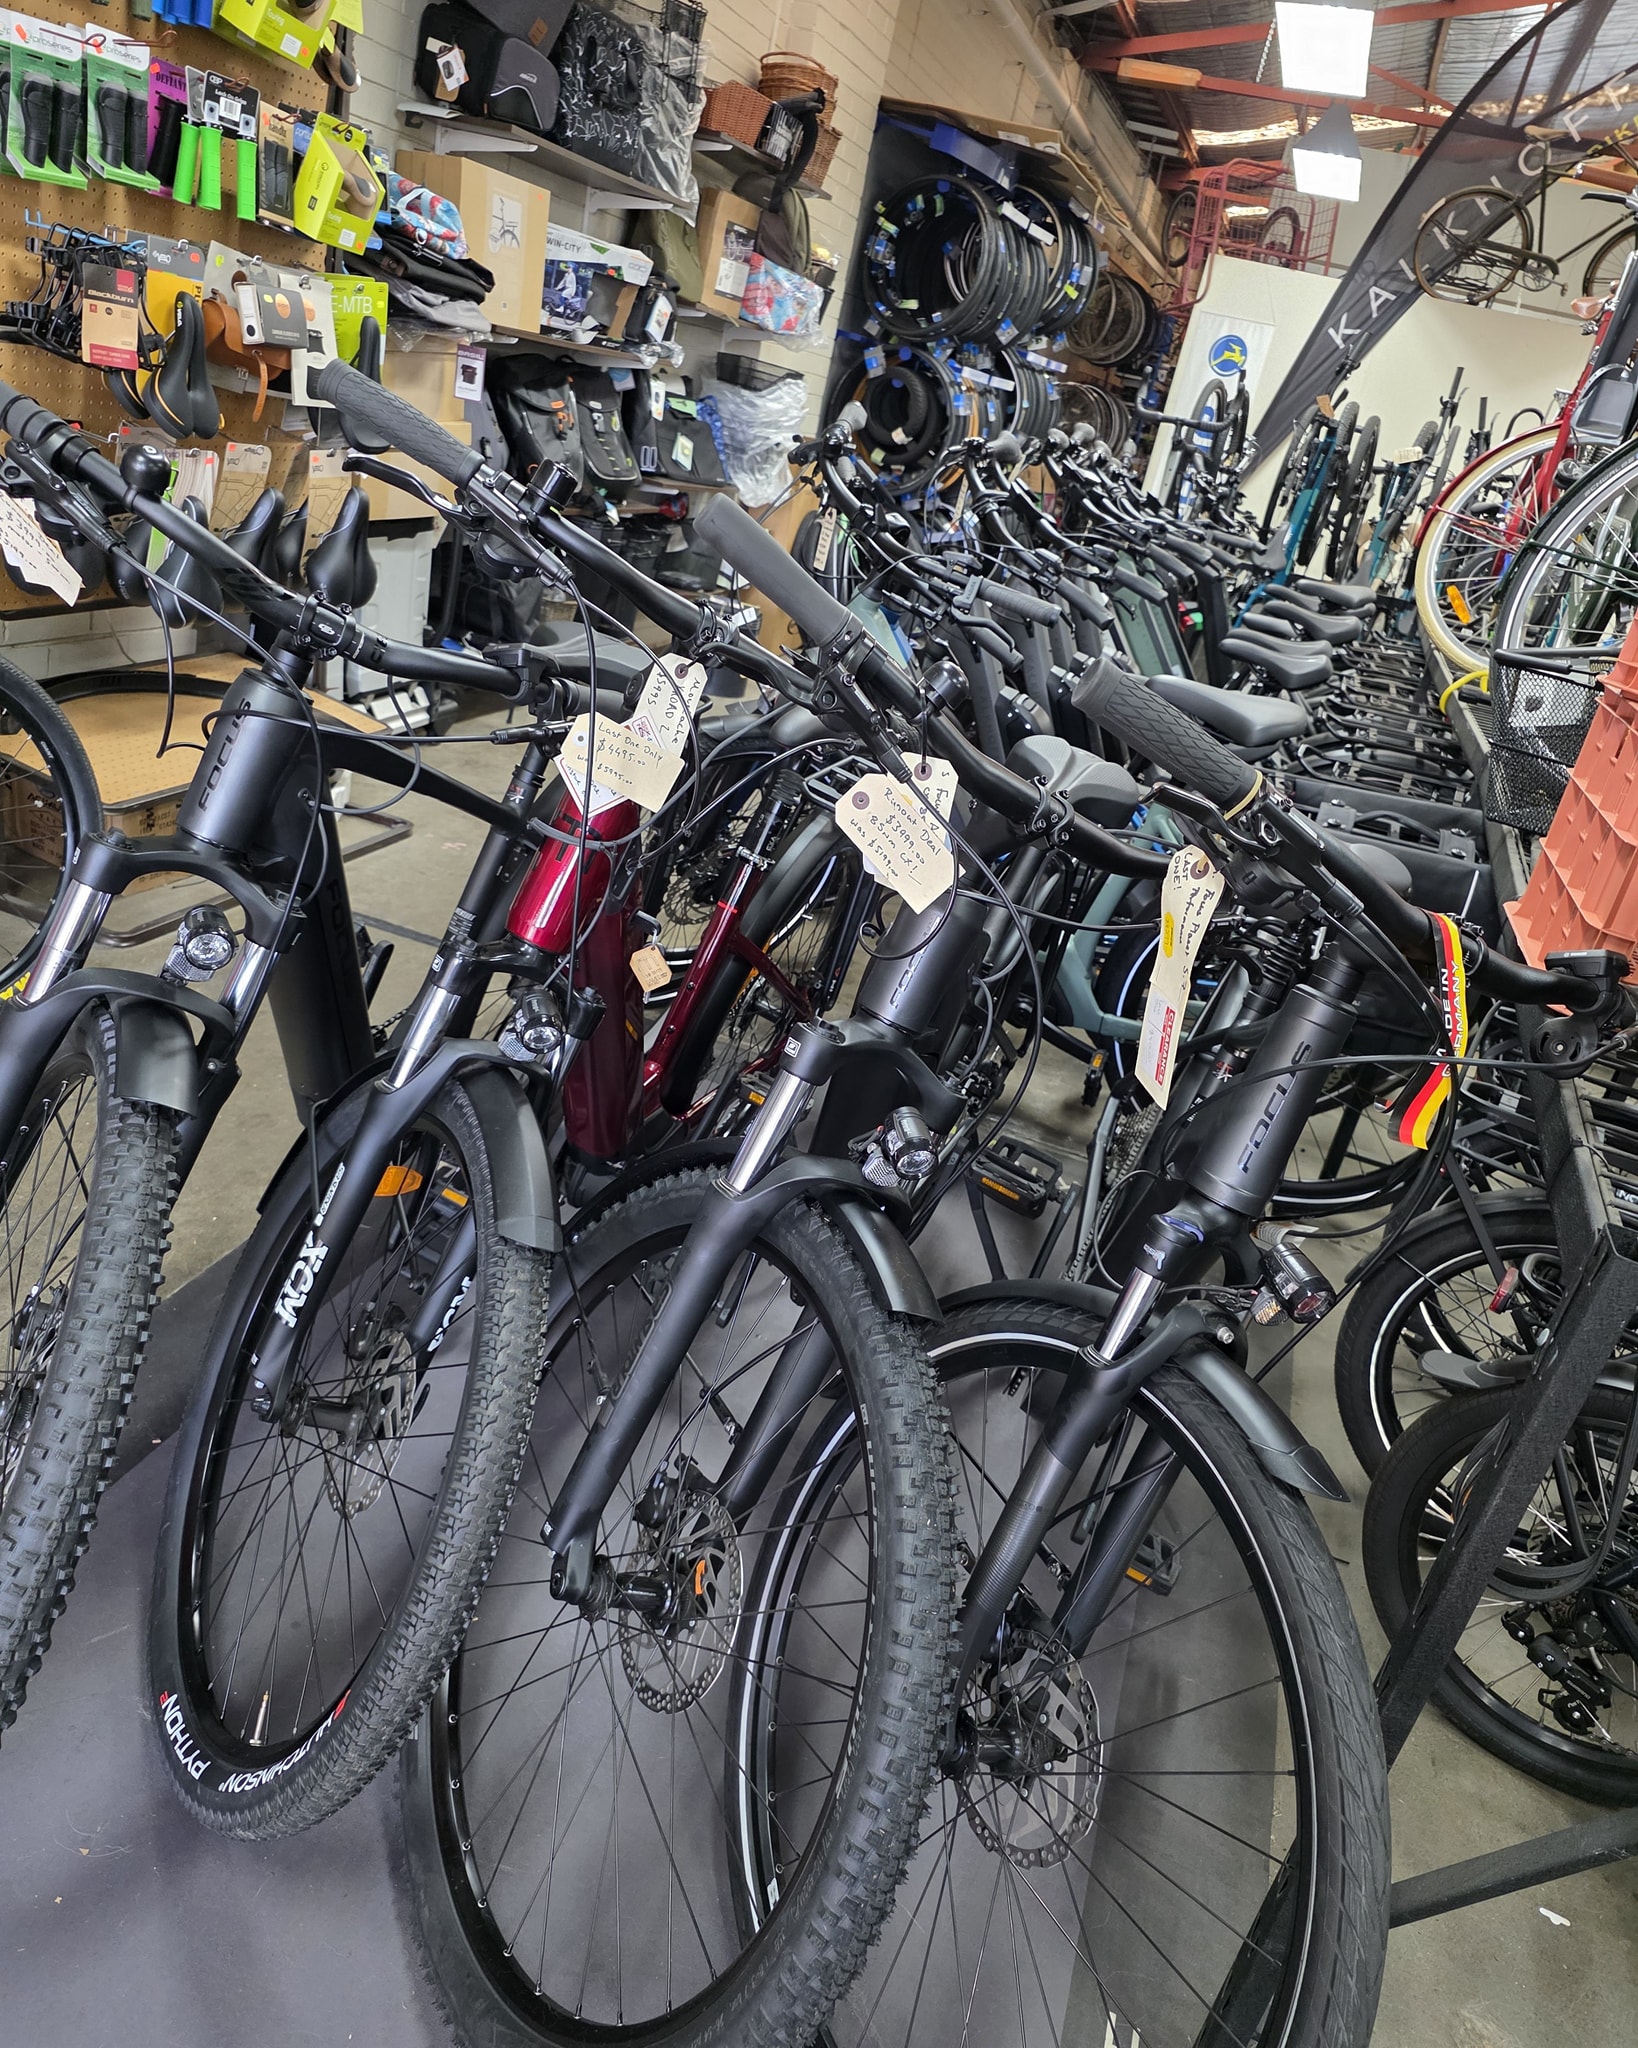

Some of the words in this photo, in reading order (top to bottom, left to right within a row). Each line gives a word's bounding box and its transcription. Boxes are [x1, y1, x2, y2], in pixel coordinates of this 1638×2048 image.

[87, 289, 135, 304] Blackburn
[332, 296, 373, 314] E-MTB
[198, 697, 252, 812] FOCUS
[598, 721, 622, 739] Last
[624, 736, 641, 750] One
[643, 745, 664, 769] Only
[919, 828, 942, 857] Deal
[1182, 852, 1193, 881] LAST
[1441, 967, 1450, 992] IN
[1158, 1010, 1175, 1086] CLEARANCE
[1237, 1040, 1313, 1175] FOCUS
[274, 1230, 330, 1329] XCM
[161, 1693, 212, 1781] PYTHON
[222, 1710, 335, 1794] HUTCHINSON
